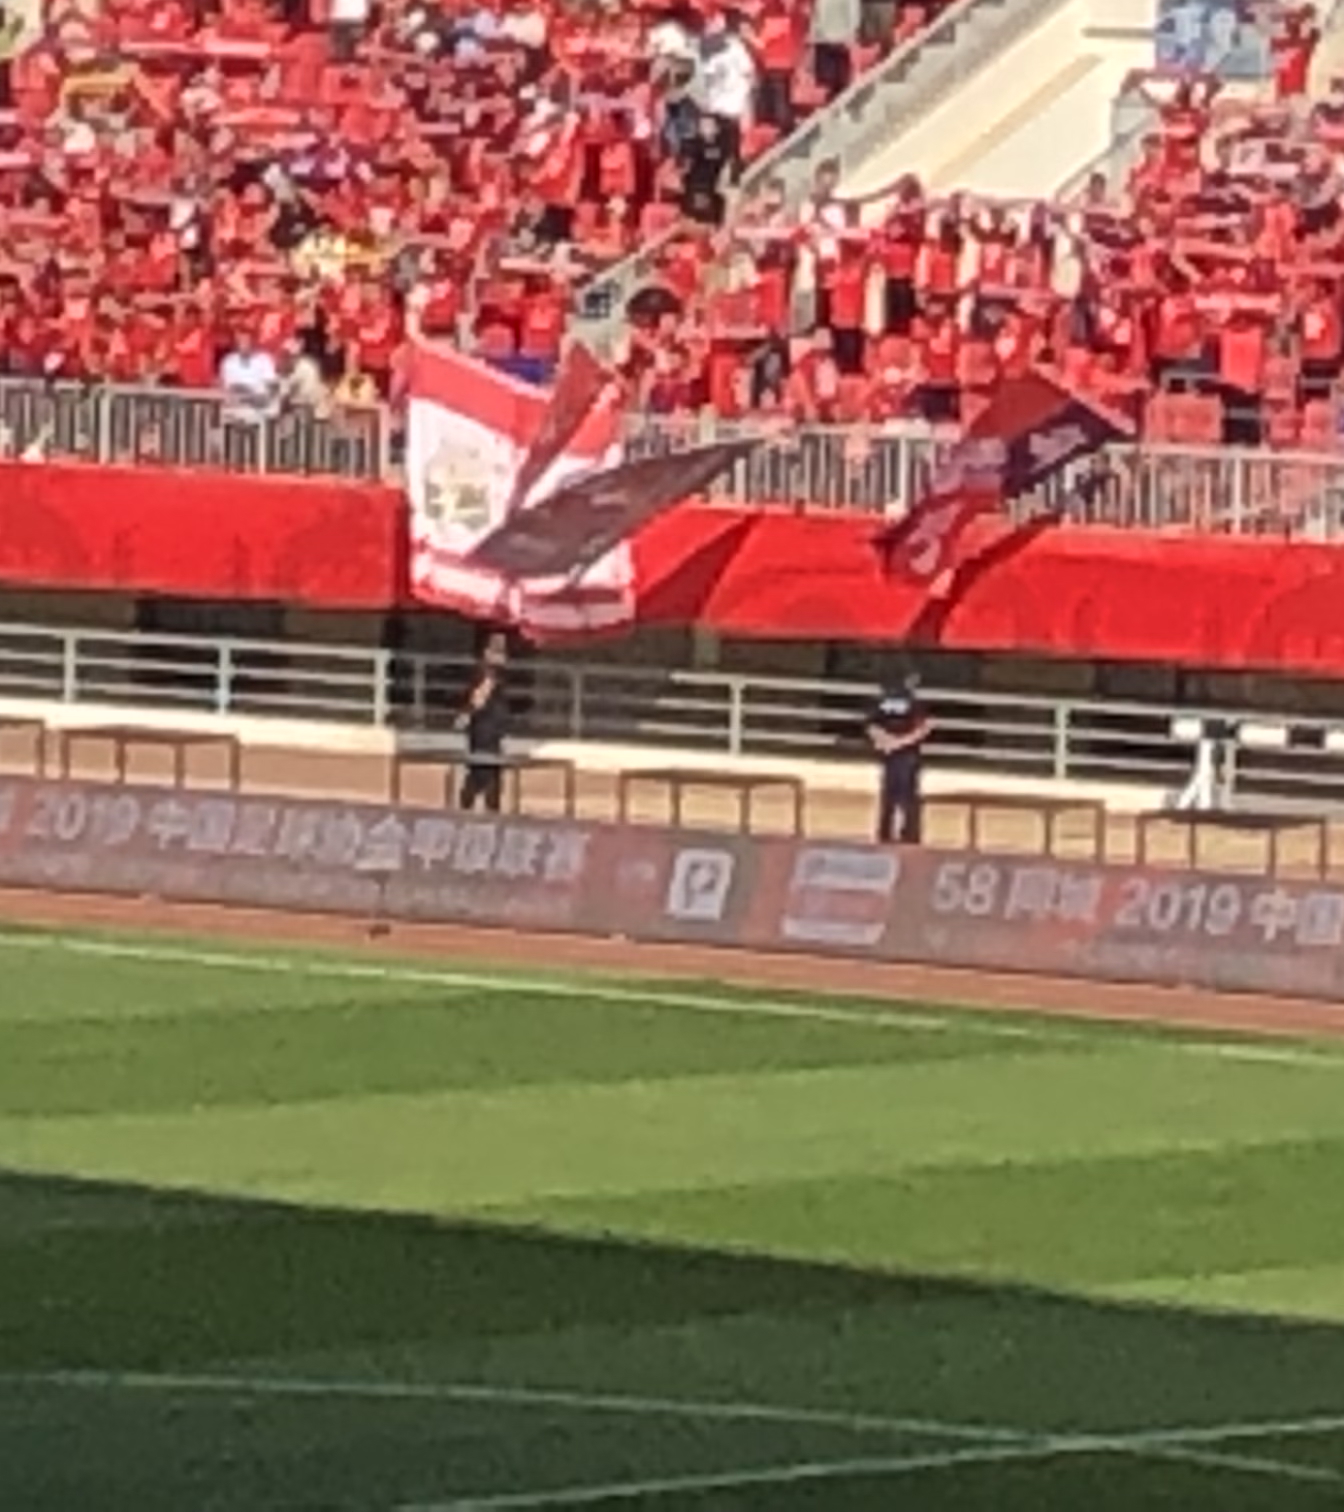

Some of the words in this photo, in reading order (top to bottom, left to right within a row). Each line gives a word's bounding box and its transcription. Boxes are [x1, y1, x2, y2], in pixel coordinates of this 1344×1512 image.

[27, 786, 141, 845] 2019
[931, 862, 999, 918] 58
[1115, 876, 1243, 937] 2019
